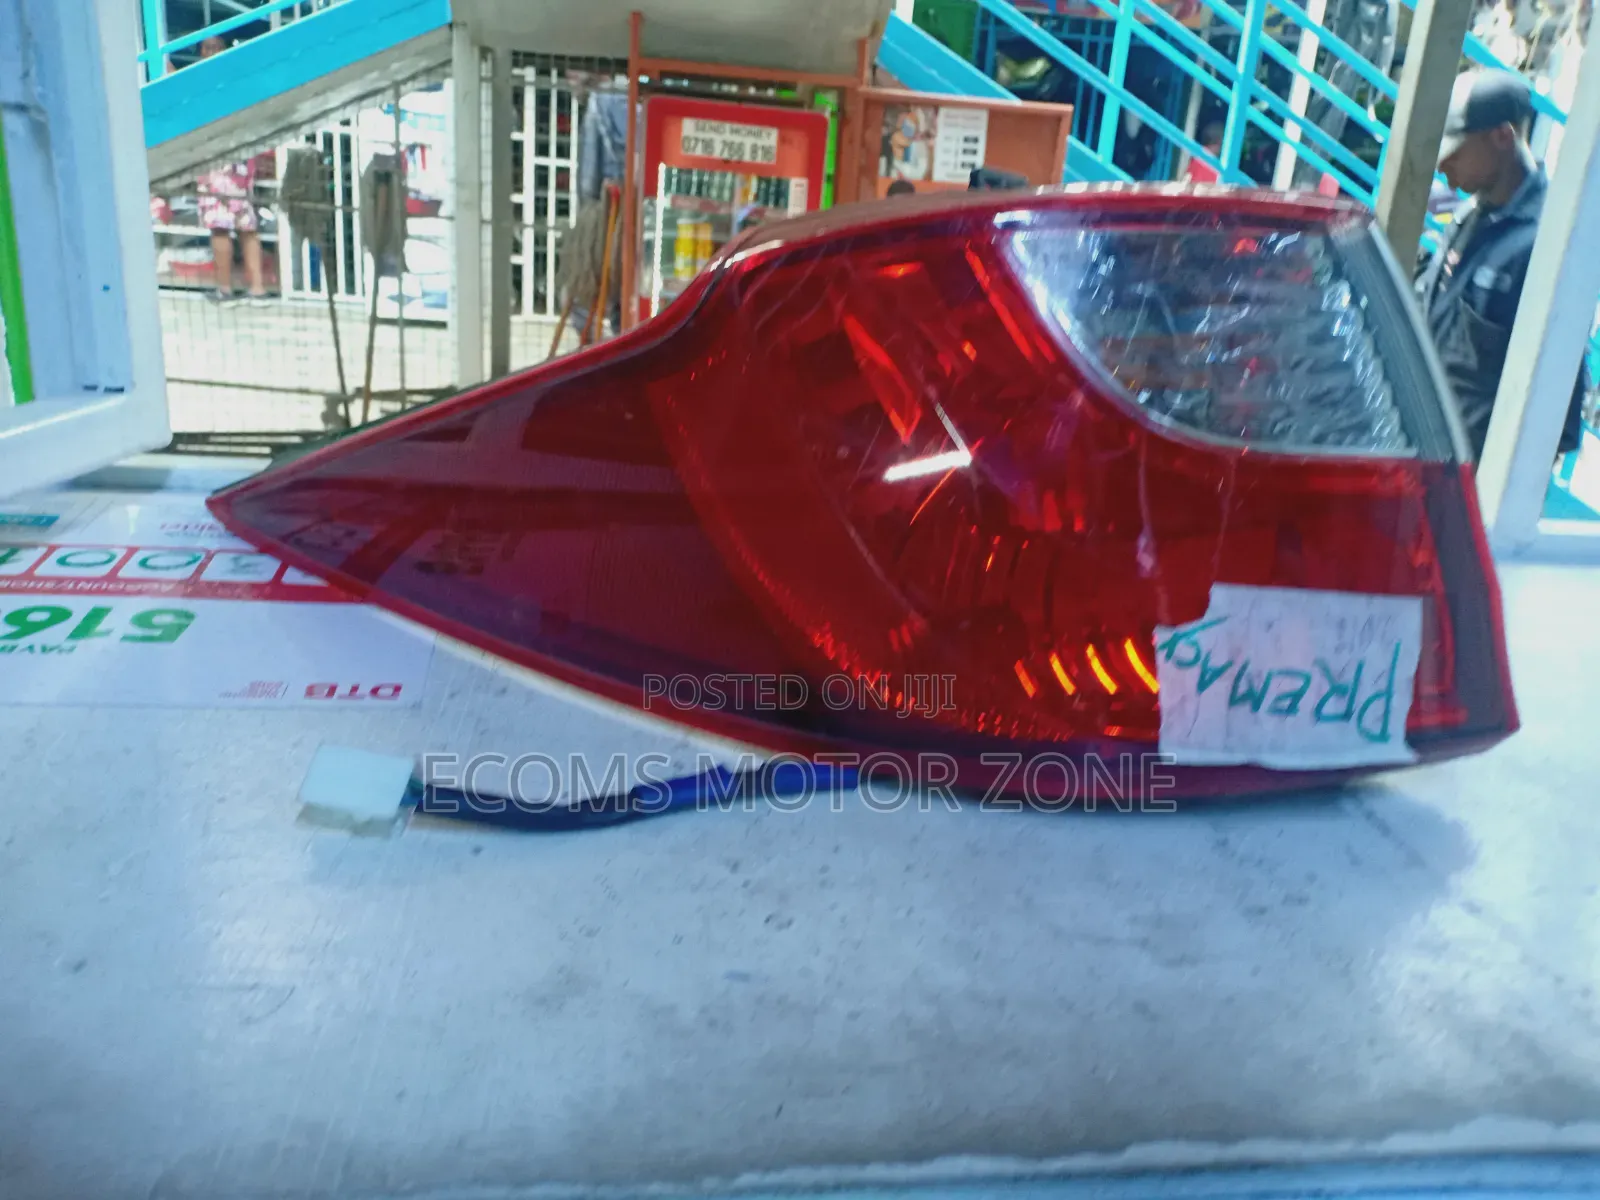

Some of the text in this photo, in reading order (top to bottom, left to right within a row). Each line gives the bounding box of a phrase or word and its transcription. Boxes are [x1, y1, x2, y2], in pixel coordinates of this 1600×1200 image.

[694, 120, 773, 140] SEND MONEY
[0, 604, 196, 644] 516
[304, 682, 403, 701] DTB
